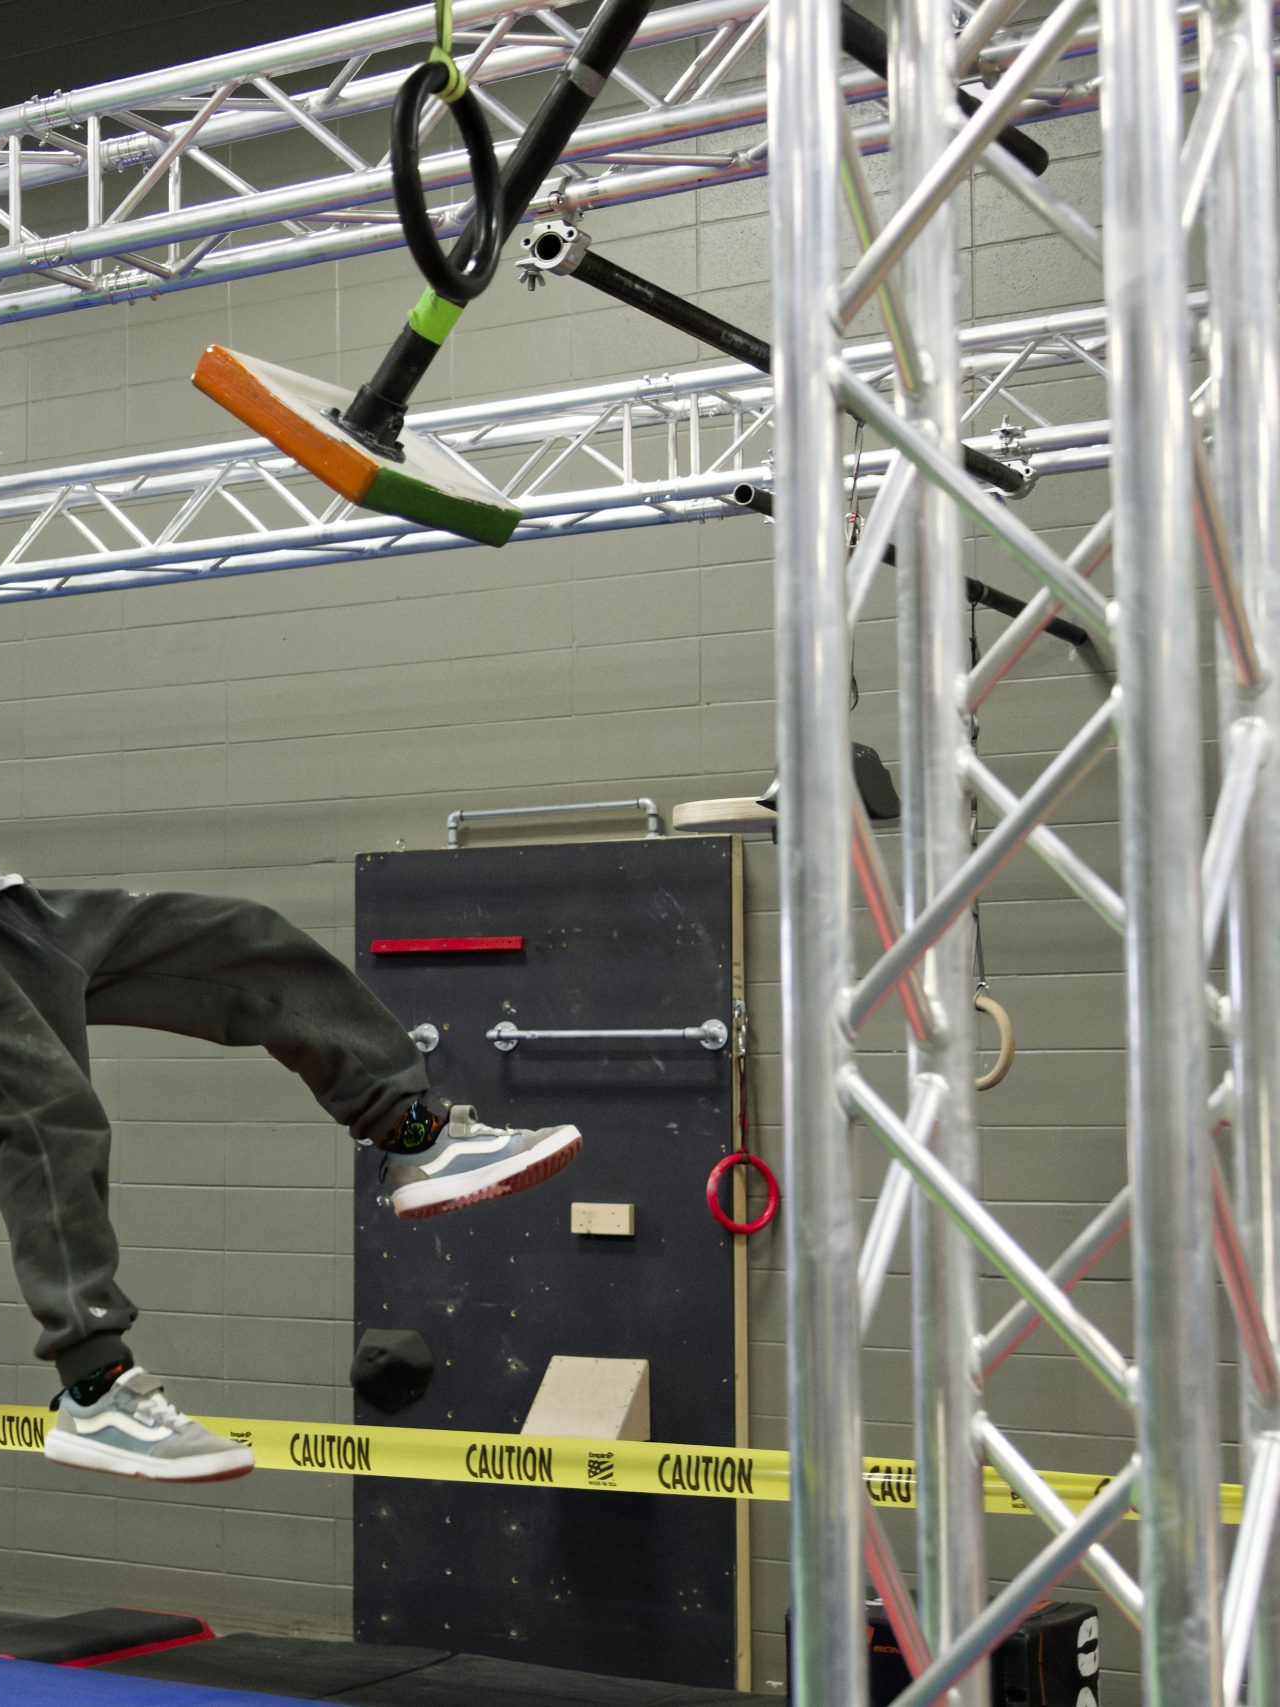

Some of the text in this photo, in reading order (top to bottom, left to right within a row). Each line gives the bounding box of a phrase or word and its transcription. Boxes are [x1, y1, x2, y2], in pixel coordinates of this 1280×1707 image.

[290, 1433, 371, 1471] CAUTION
[465, 1443, 553, 1483] CAUTION
[657, 1454, 754, 1494] CAUTION
